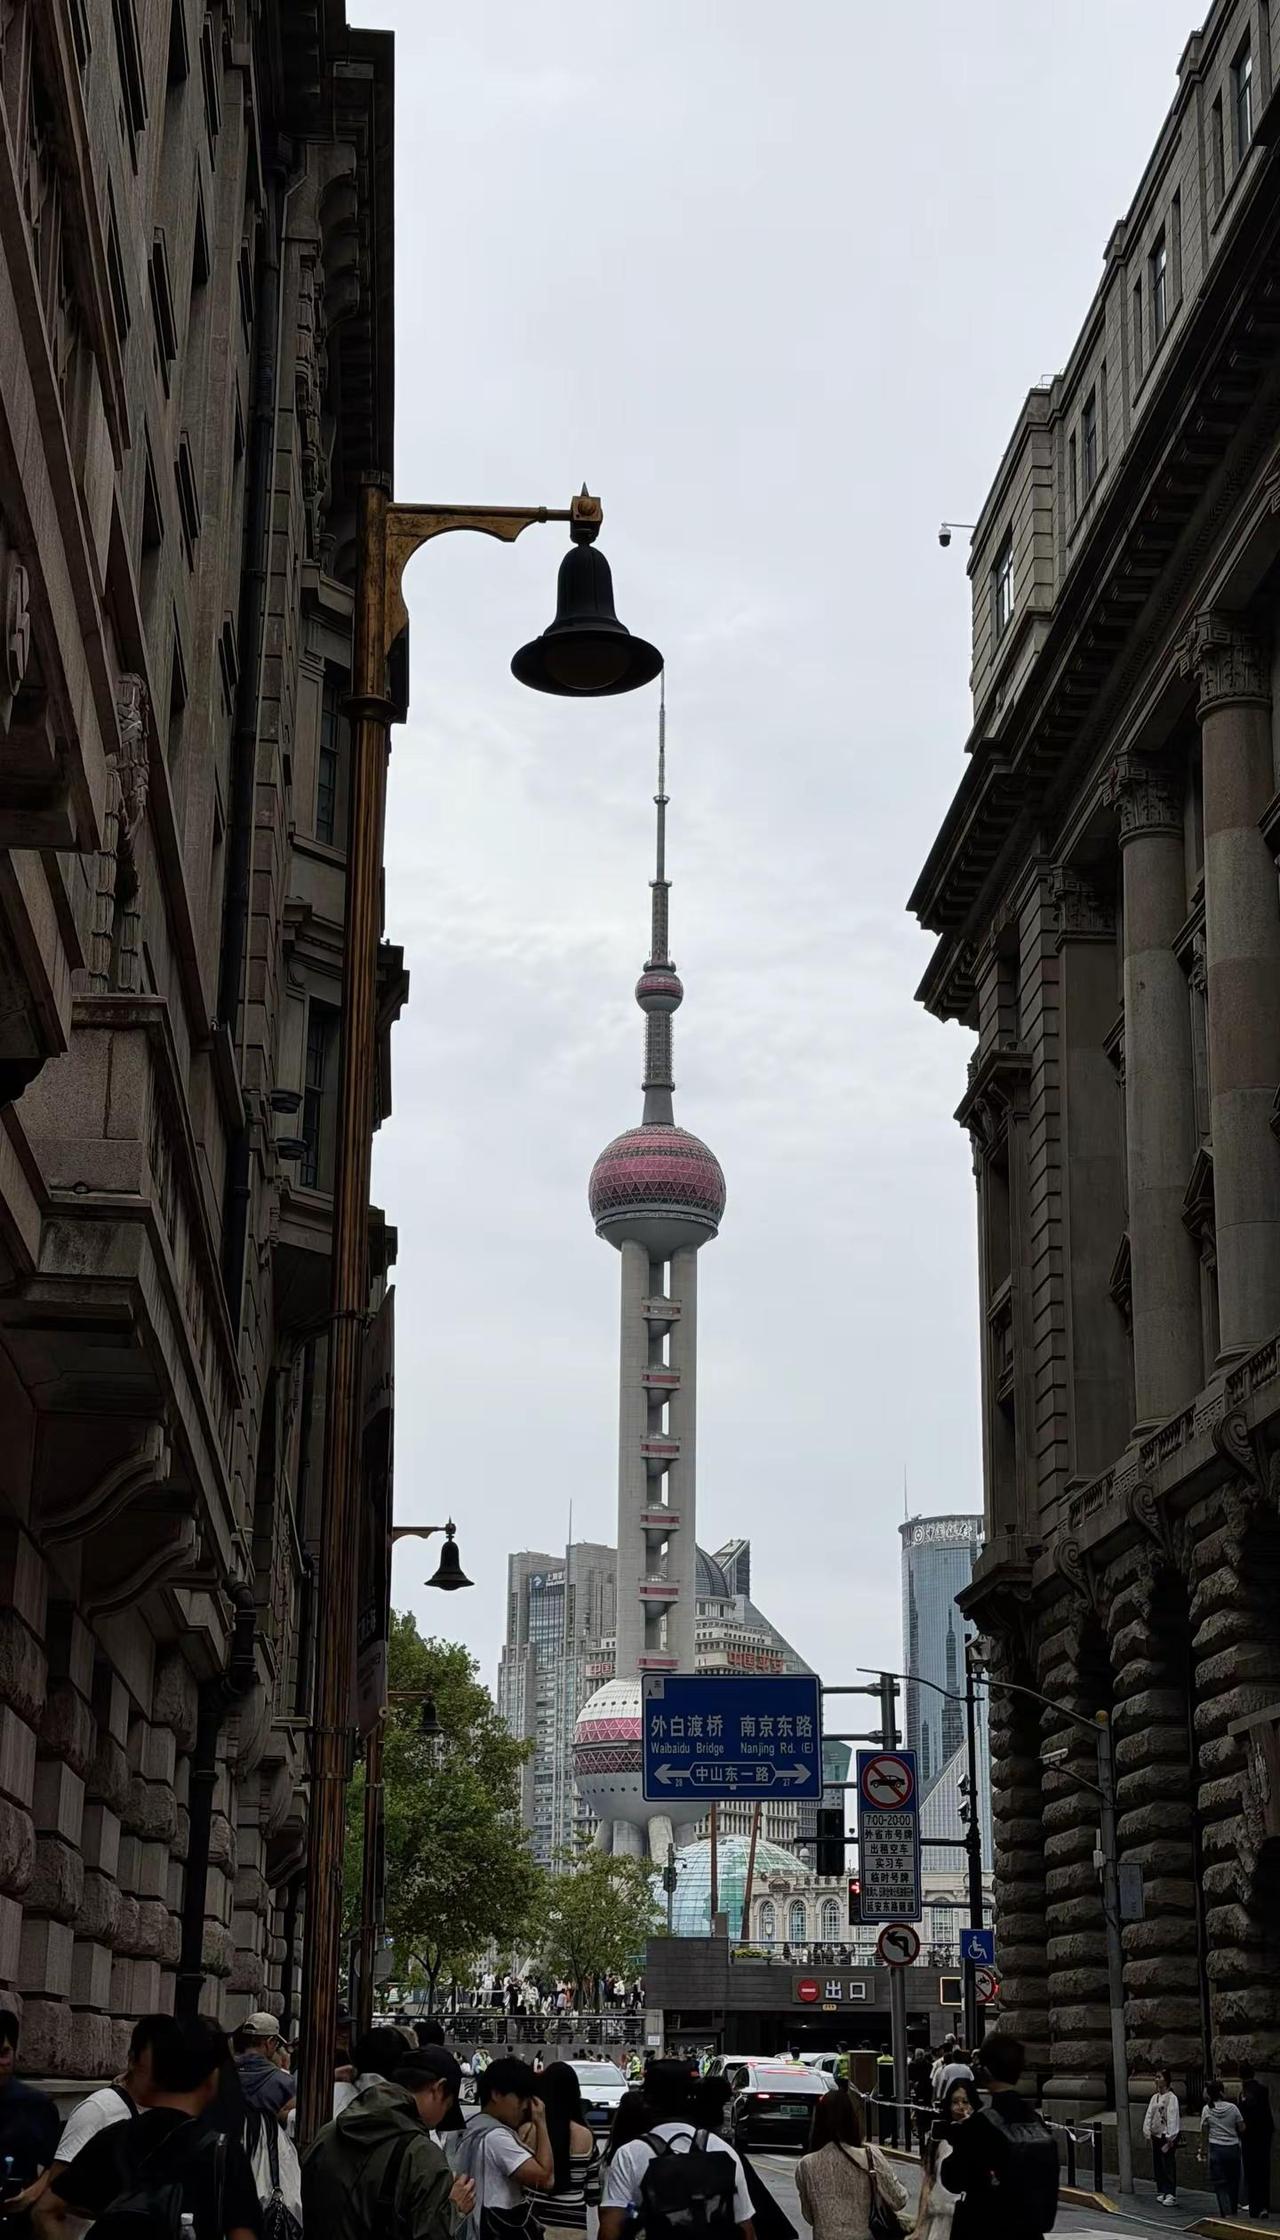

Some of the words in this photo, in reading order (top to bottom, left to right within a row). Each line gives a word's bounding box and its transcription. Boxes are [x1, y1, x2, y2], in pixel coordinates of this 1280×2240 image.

[651, 1715, 723, 1738] 外白渡桥
[740, 1715, 813, 1738] 南京东路
[651, 1742, 690, 1754] Waibaidu
[696, 1742, 725, 1757] Bridge
[740, 1742, 775, 1757] Nanjing
[780, 1742, 796, 1754] Rd.
[801, 1742, 814, 1755] (E)
[695, 1766, 769, 1783] 中山东一路
[864, 1829, 913, 1841] 外省市号牌
[875, 1858, 904, 1869] 实习车
[871, 1872, 909, 1883] 临时号牌
[825, 1980, 866, 2000] 出口
